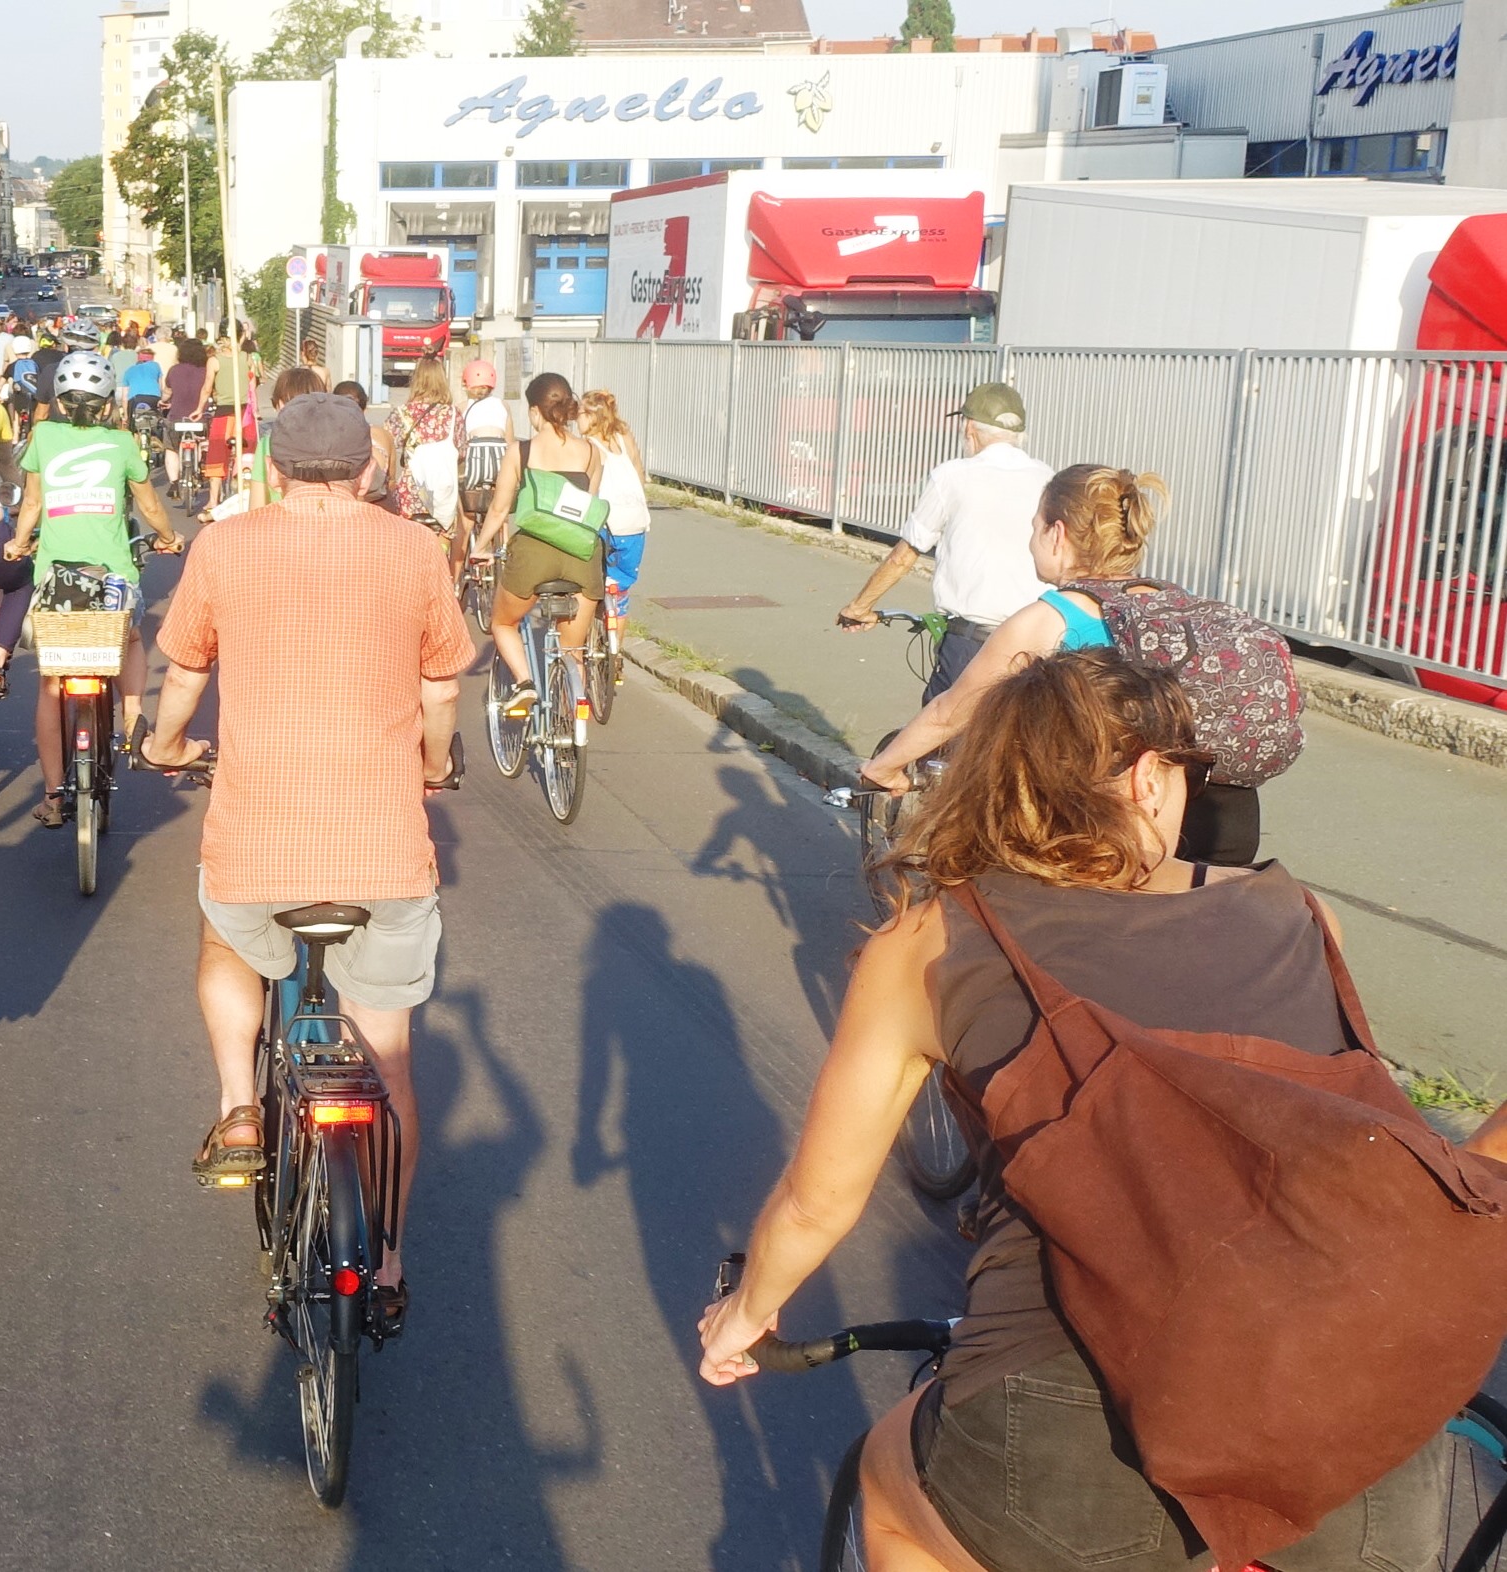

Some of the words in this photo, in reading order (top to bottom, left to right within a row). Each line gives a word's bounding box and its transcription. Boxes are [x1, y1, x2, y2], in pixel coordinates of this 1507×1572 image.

[443, 75, 764, 139] Agnello
[821, 227, 946, 238] GastroExpress
[559, 273, 574, 293] 2
[631, 269, 702, 314] GastroExpress
[44, 652, 62, 661] FEIN
[72, 652, 116, 662] STAUBFREI
